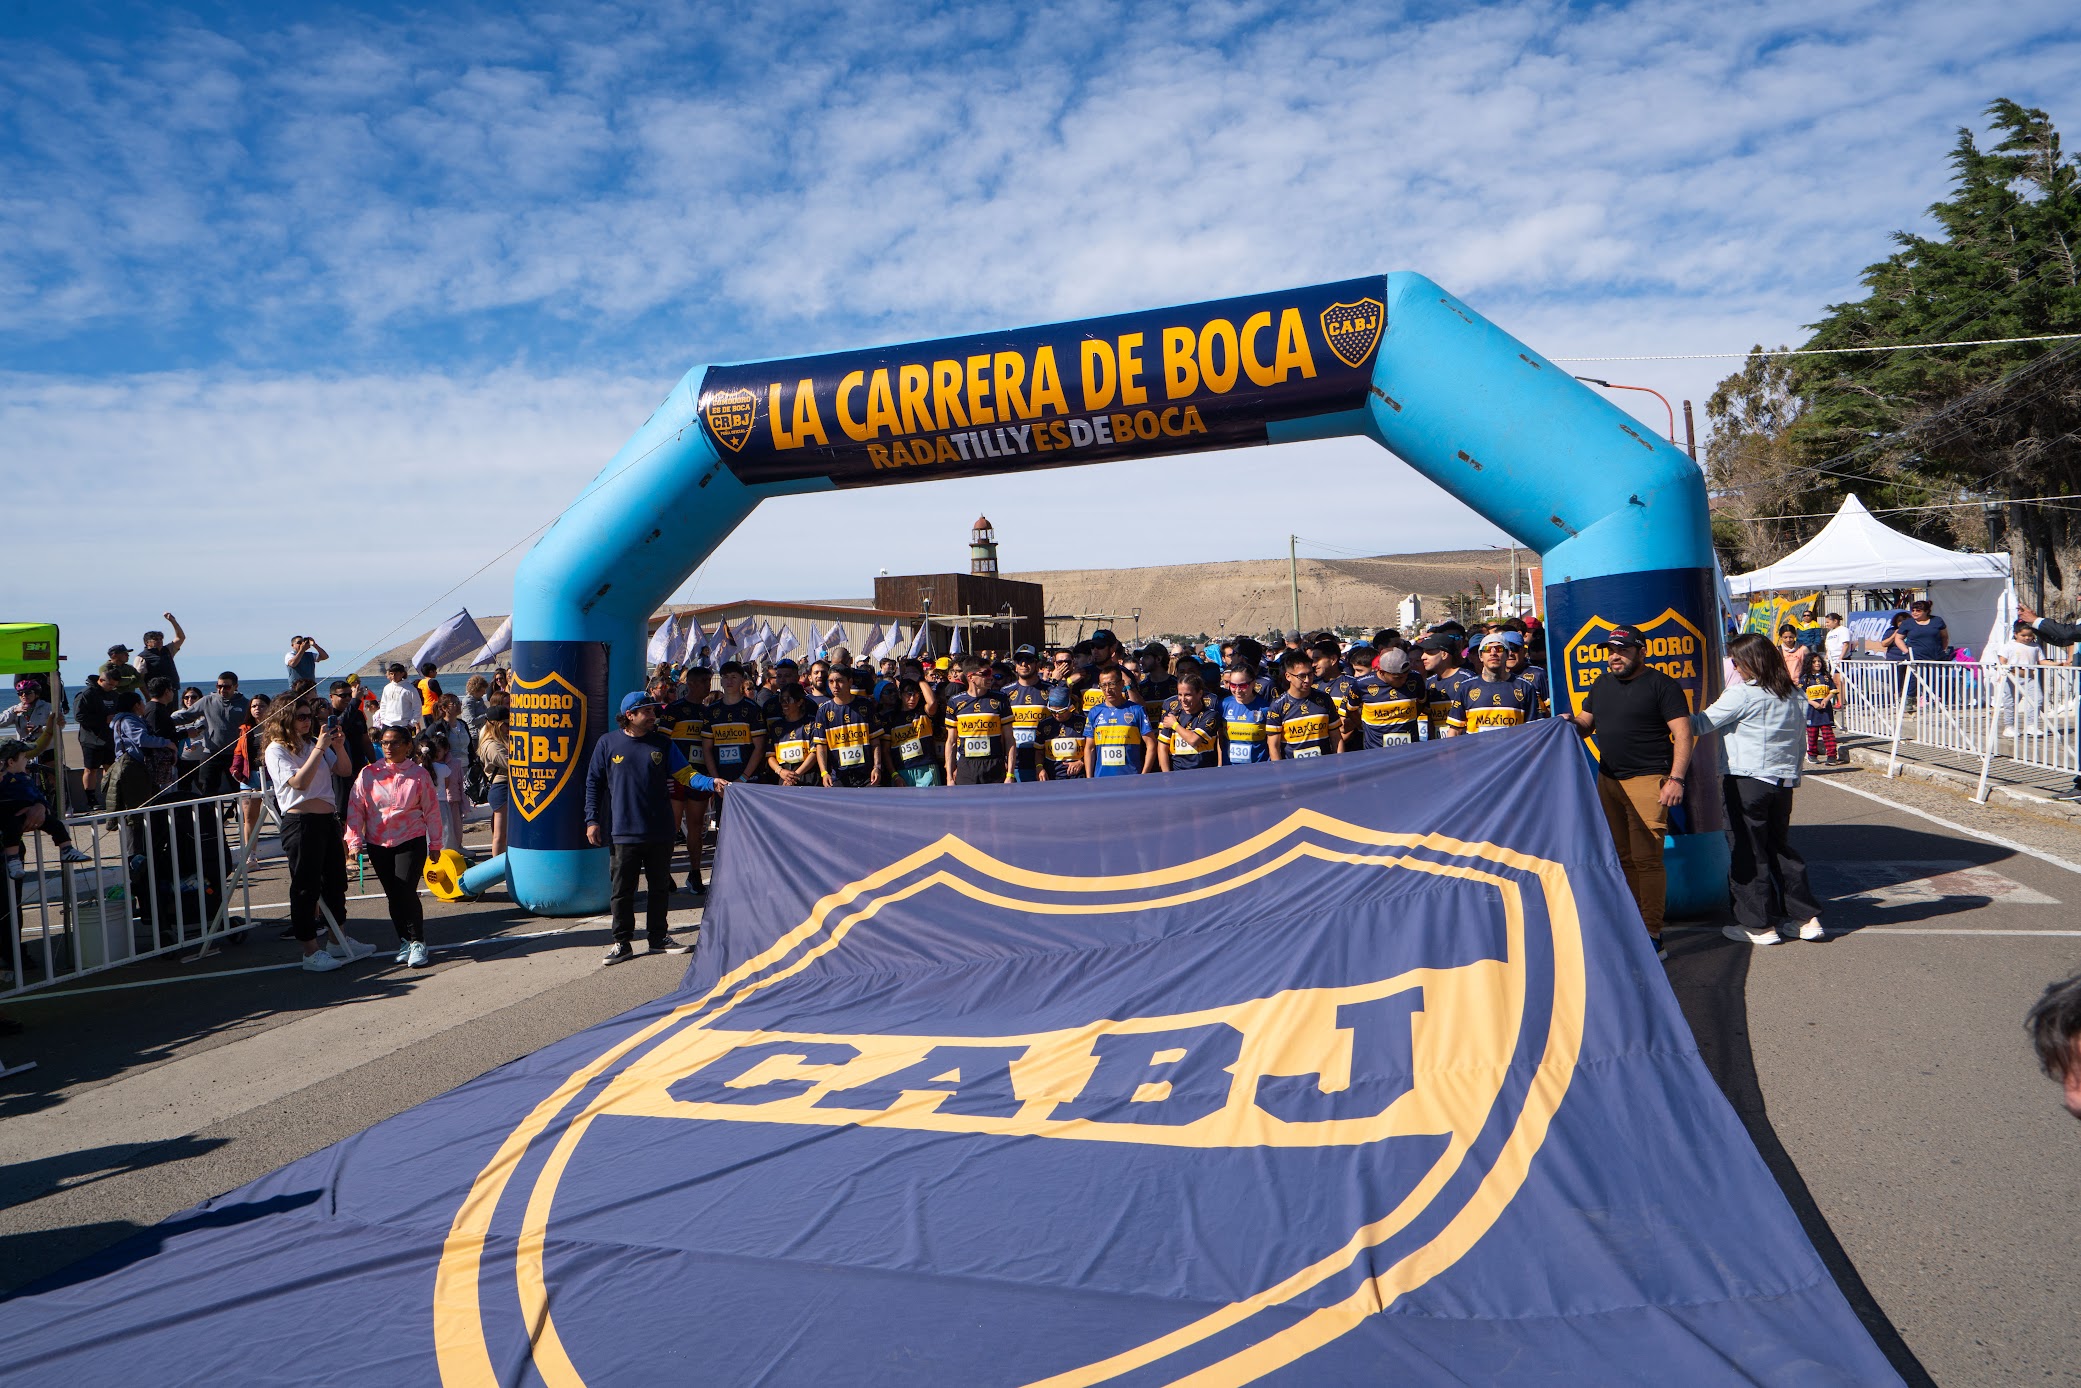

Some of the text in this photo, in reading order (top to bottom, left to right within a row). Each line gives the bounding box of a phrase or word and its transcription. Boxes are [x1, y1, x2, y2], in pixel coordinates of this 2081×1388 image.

[1329, 315, 1377, 336] CABJ
[769, 307, 1318, 451] LA CARRERA DE BOCA
[732, 404, 751, 412] BOCA
[510, 694, 573, 709] OMODORO
[516, 713, 529, 727] DE
[531, 713, 573, 728] BOCA
[1015, 732, 1034, 742] 306
[901, 741, 919, 754] 058
[967, 741, 988, 750] 003
[1054, 741, 1074, 751] 002
[1230, 746, 1249, 756] 430
[720, 748, 738, 758] 373
[783, 748, 801, 758] 130
[842, 749, 861, 760] 126
[1103, 749, 1123, 758] 108
[512, 766, 557, 779] RADA TILLY
[516, 778, 546, 790] 20 25
[665, 986, 1424, 1126] CABJ
